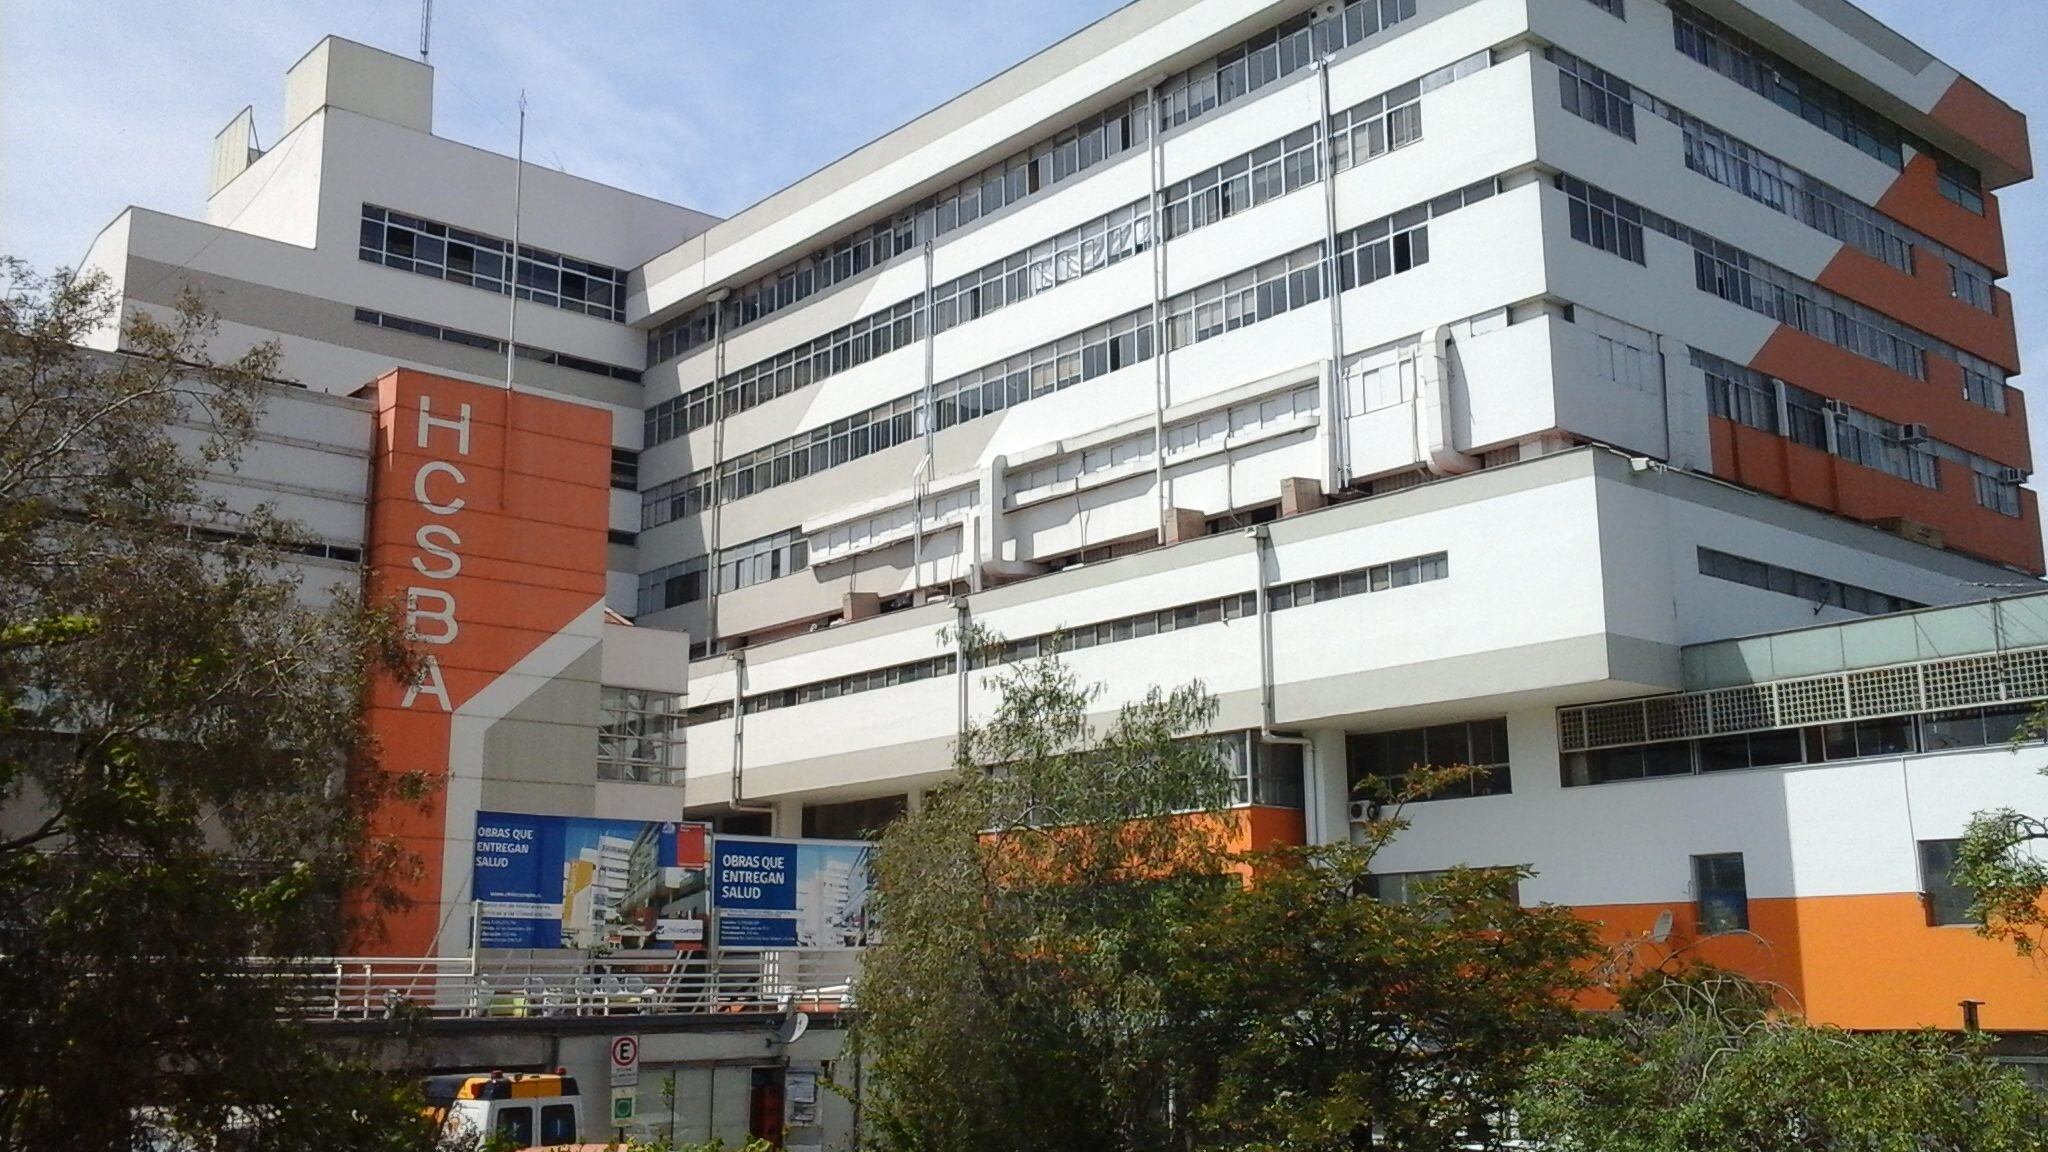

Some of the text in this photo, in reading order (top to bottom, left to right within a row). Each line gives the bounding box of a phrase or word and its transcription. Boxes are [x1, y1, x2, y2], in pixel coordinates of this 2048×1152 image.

[400, 395, 472, 712] HCSBA
[477, 827, 534, 840] OBRAS QUE
[476, 842, 529, 853] ENTREGAN
[475, 856, 509, 868] SALUD
[722, 854, 785, 870] OBRAS QUE
[722, 870, 785, 885] ENTREGAN
[721, 886, 762, 900] SALUD
[620, 1043, 630, 1060] E
